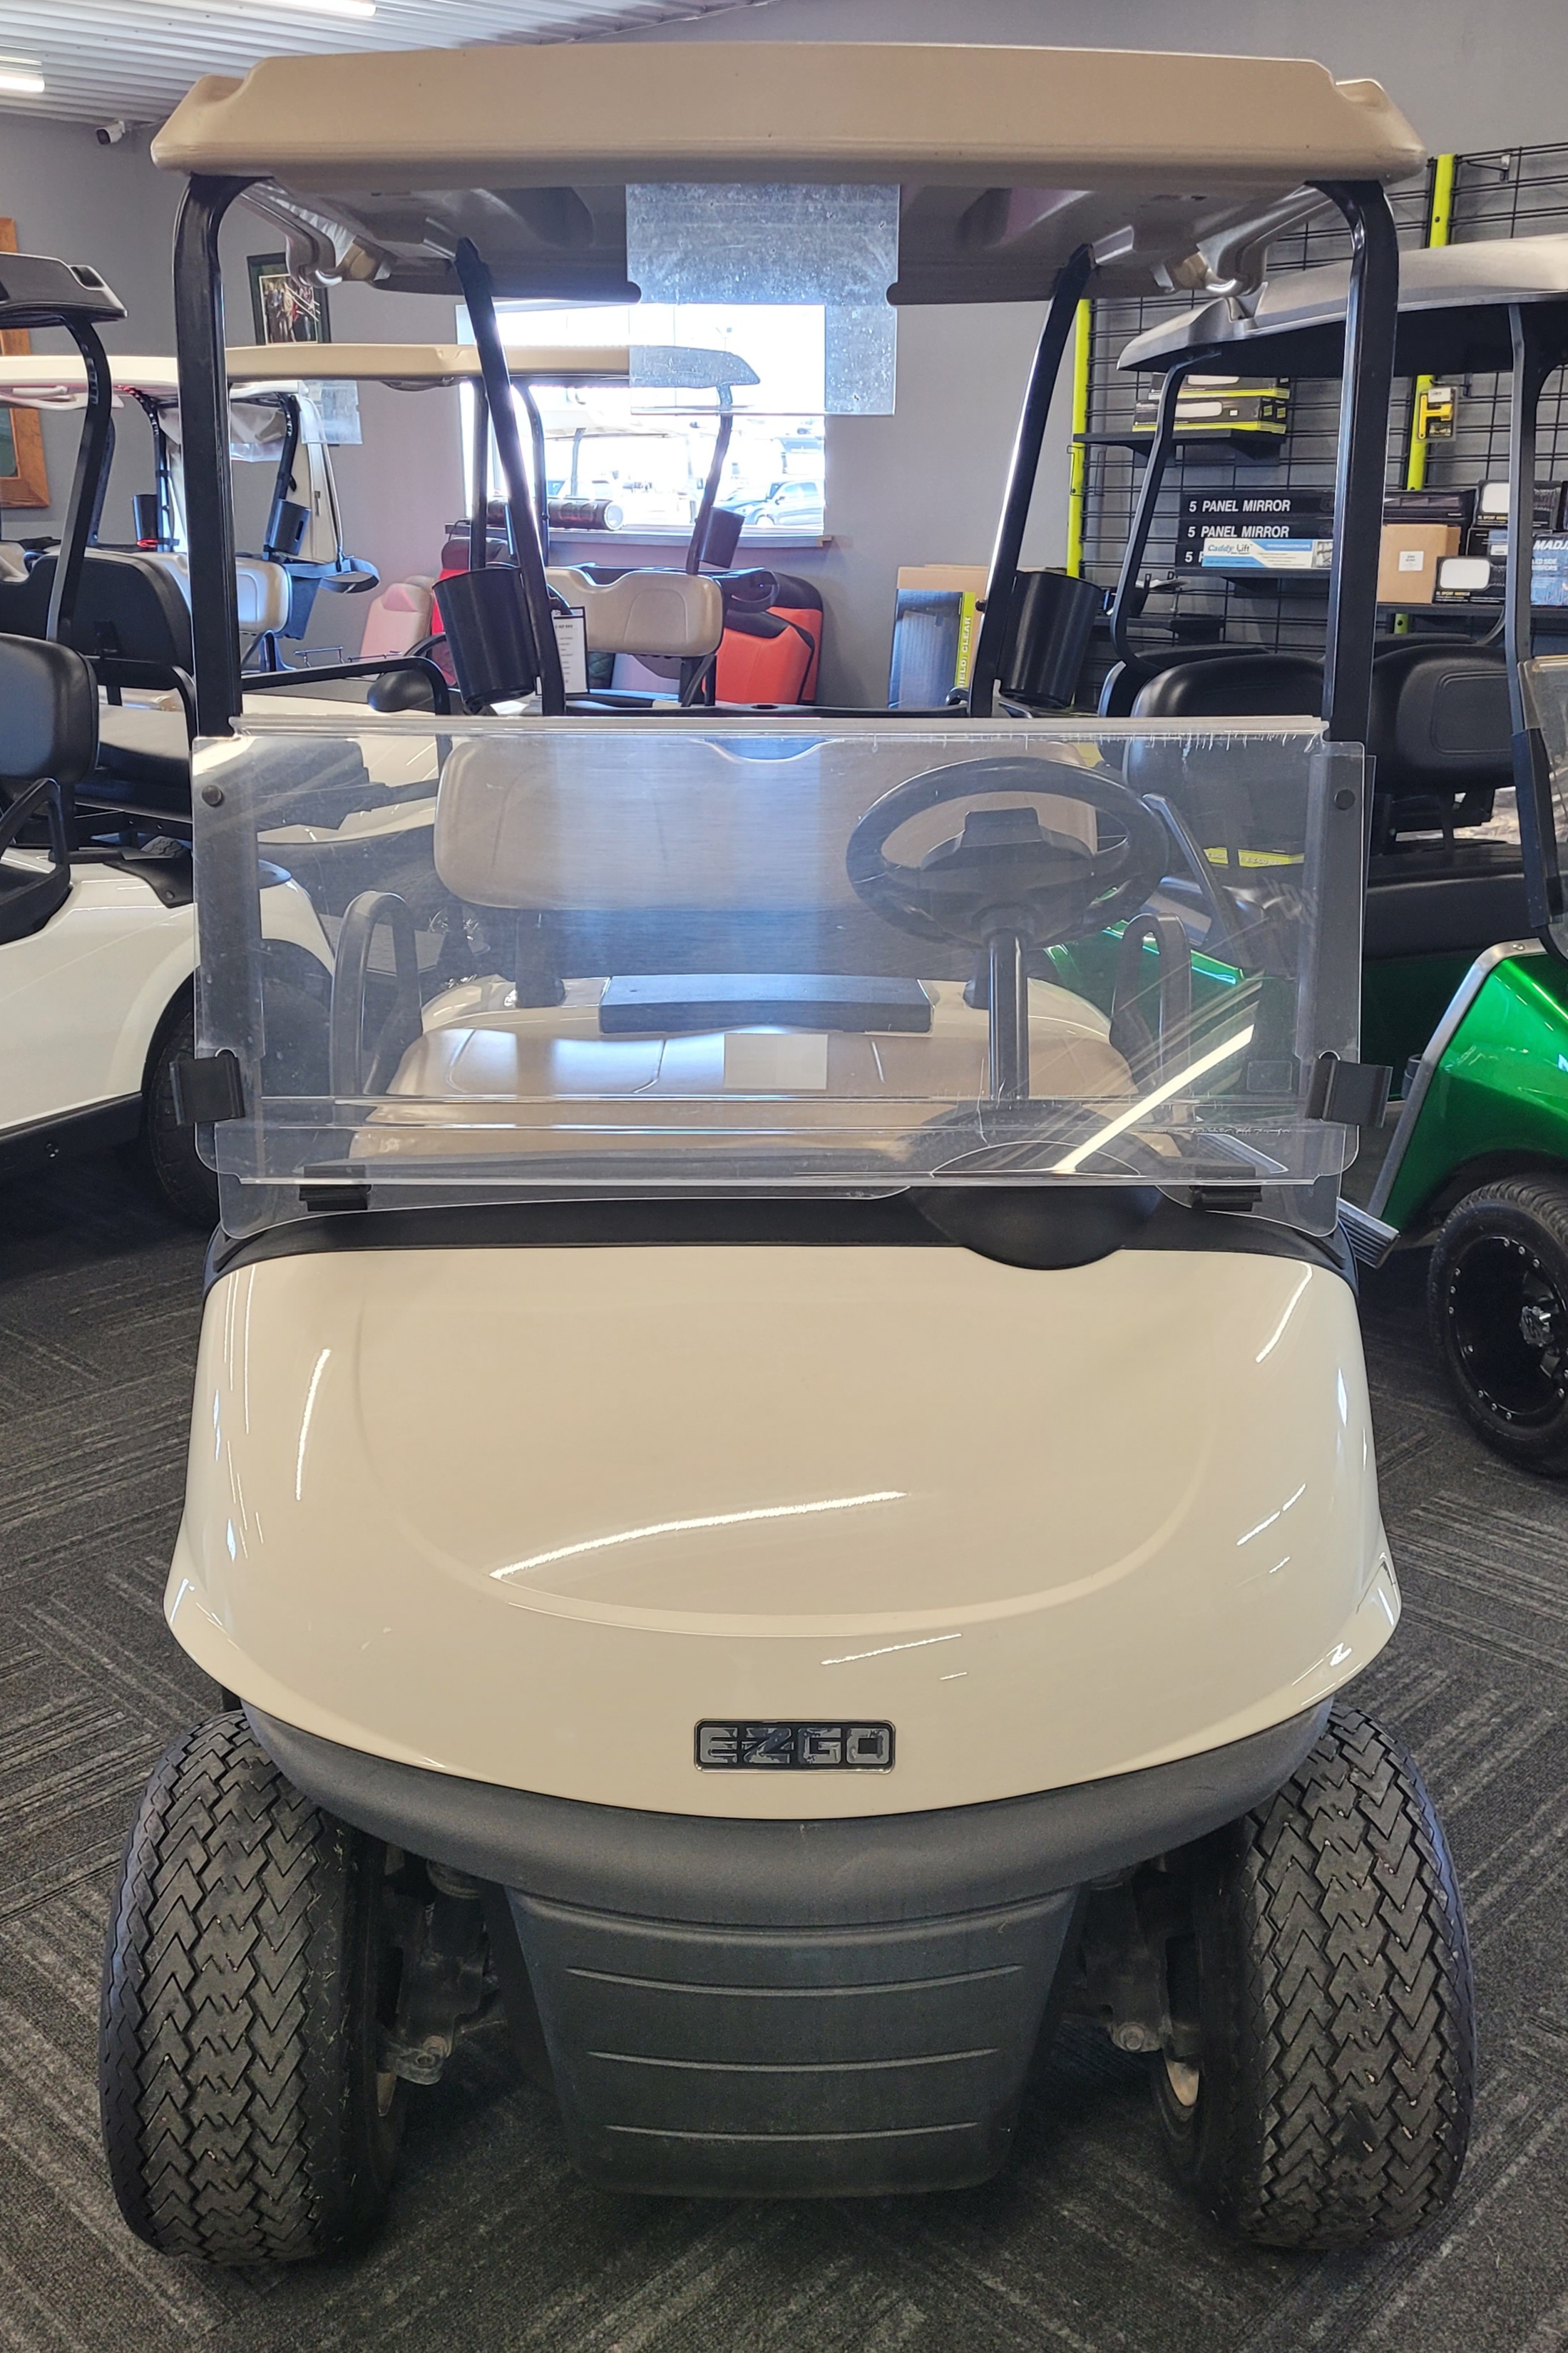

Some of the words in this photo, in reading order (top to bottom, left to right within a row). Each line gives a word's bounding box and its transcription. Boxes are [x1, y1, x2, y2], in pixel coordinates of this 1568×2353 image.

[1189, 501, 1197, 513] 5
[1201, 500, 1239, 512] PANEL
[1242, 499, 1291, 512] MIRROR
[1187, 526, 1196, 538] 5
[1201, 526, 1237, 538] PANEL
[1241, 525, 1289, 538] MIRROR
[1208, 544, 1234, 553] Caddy
[1236, 543, 1250, 552] Lift
[1532, 539, 1568, 550] MADJ
[1184, 551, 1193, 563] 5
[962, 616, 971, 653] CLEAR
